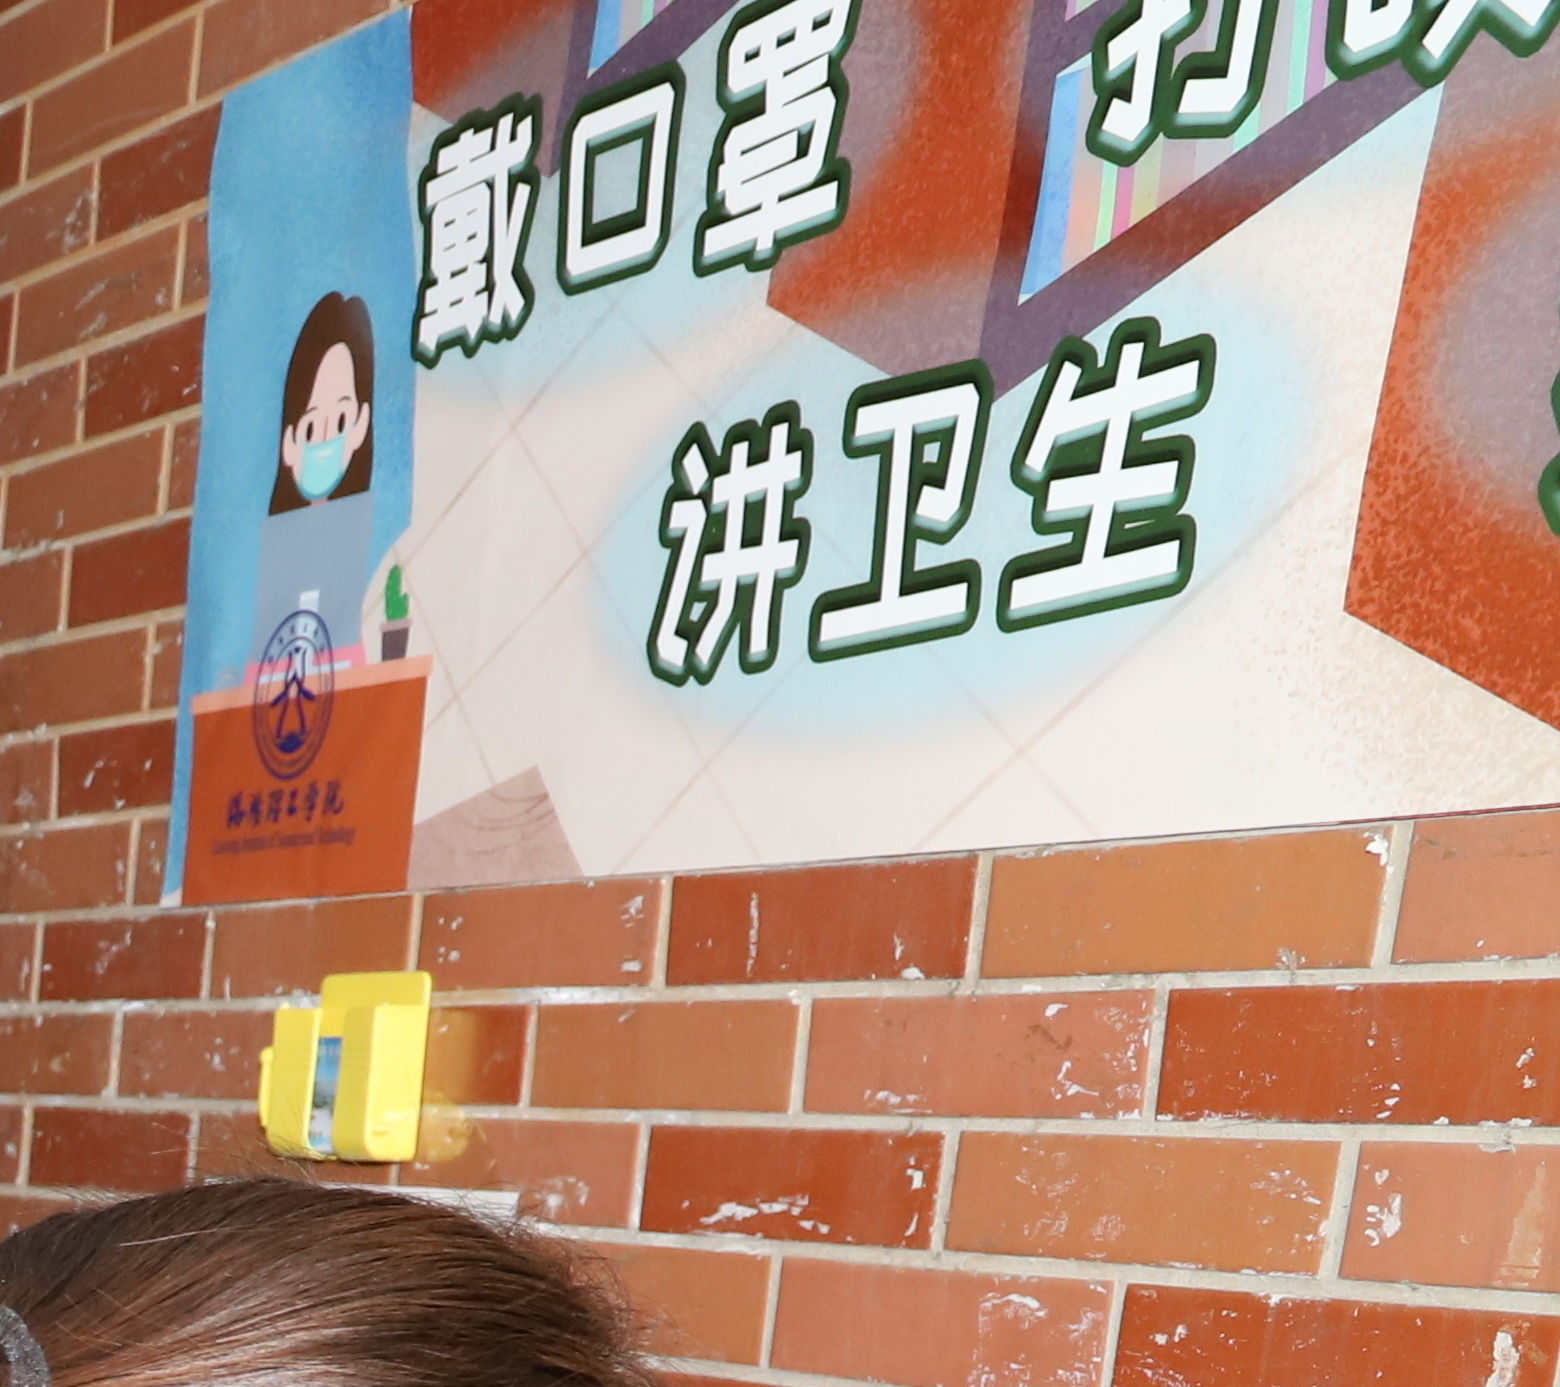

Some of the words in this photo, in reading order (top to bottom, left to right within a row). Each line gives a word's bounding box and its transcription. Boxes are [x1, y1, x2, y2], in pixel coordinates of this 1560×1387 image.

[414, 0, 858, 365] 戴口罩
[650, 318, 1215, 684] 讲卫生
